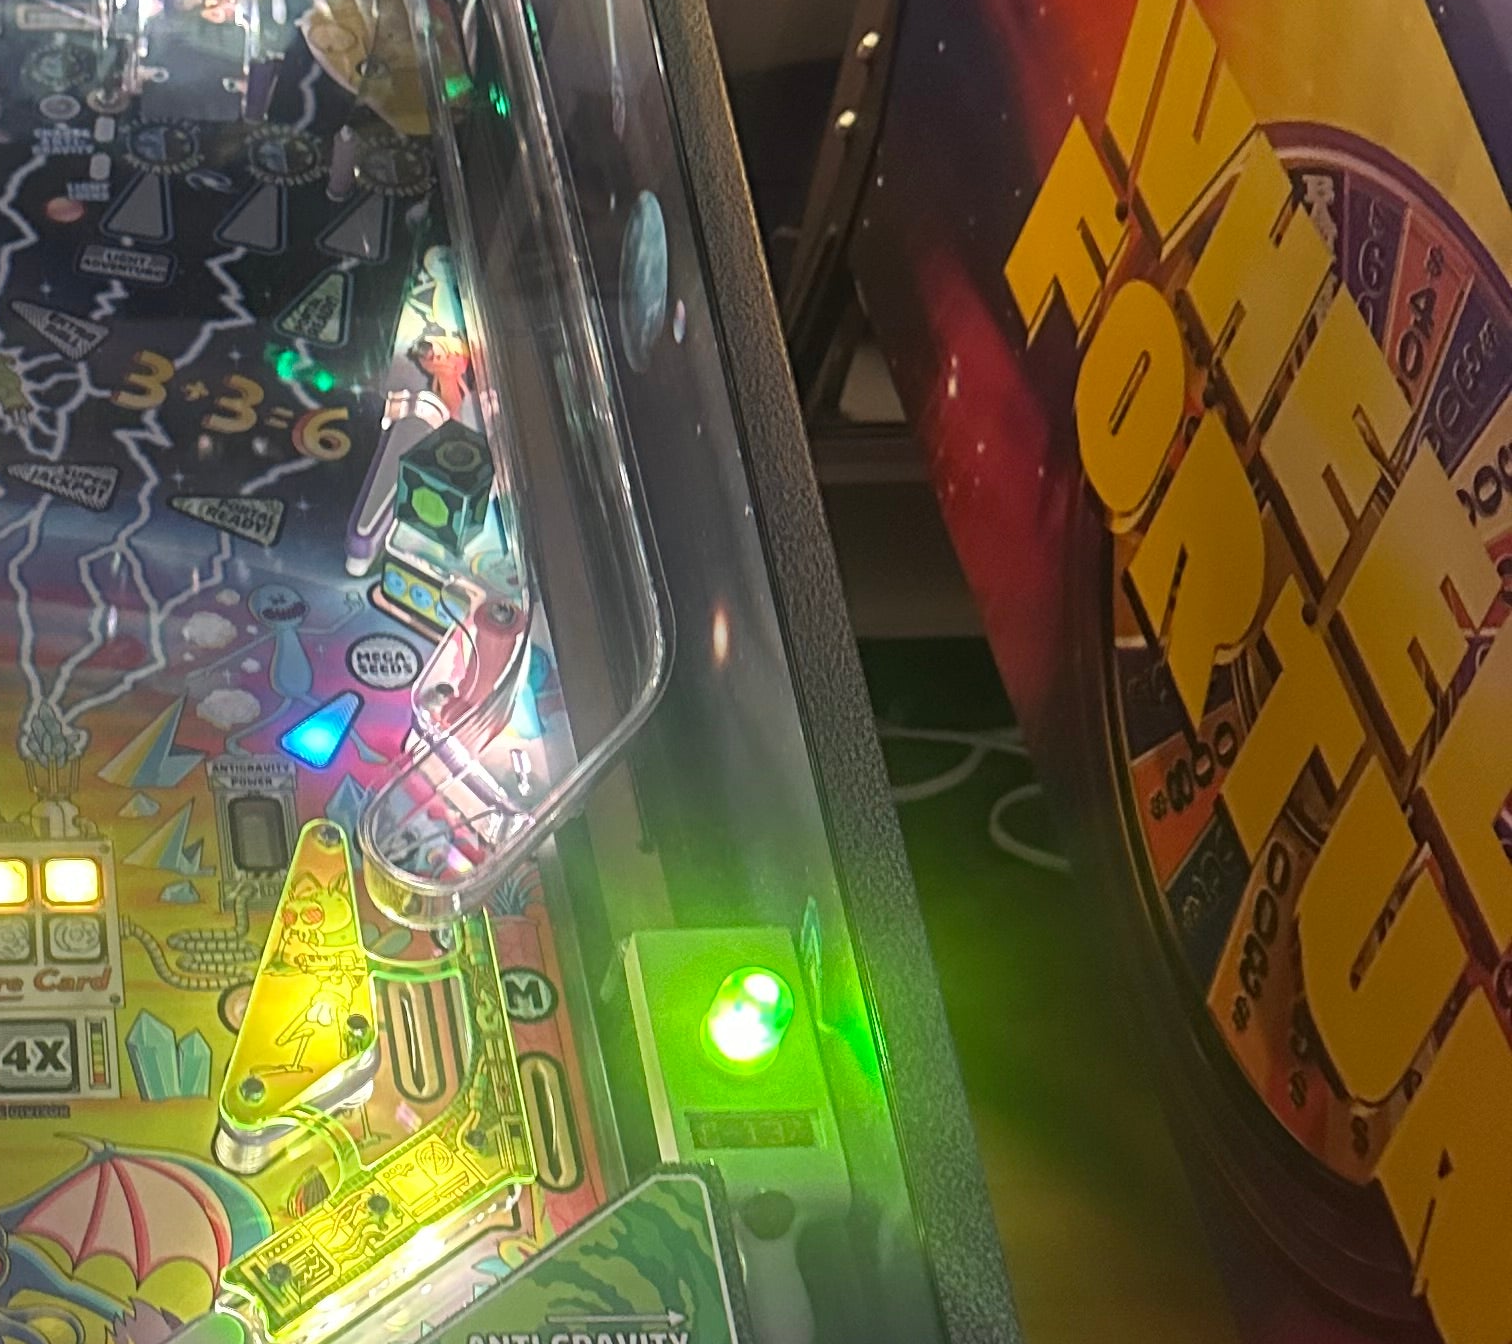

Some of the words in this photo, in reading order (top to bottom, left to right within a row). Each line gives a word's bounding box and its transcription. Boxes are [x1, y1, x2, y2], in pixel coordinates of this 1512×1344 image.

[110, 349, 175, 410] 3
[201, 374, 265, 433] 3
[291, 407, 351, 461] 6
[34, 967, 112, 993] Card
[2, 1039, 67, 1073] 4X
